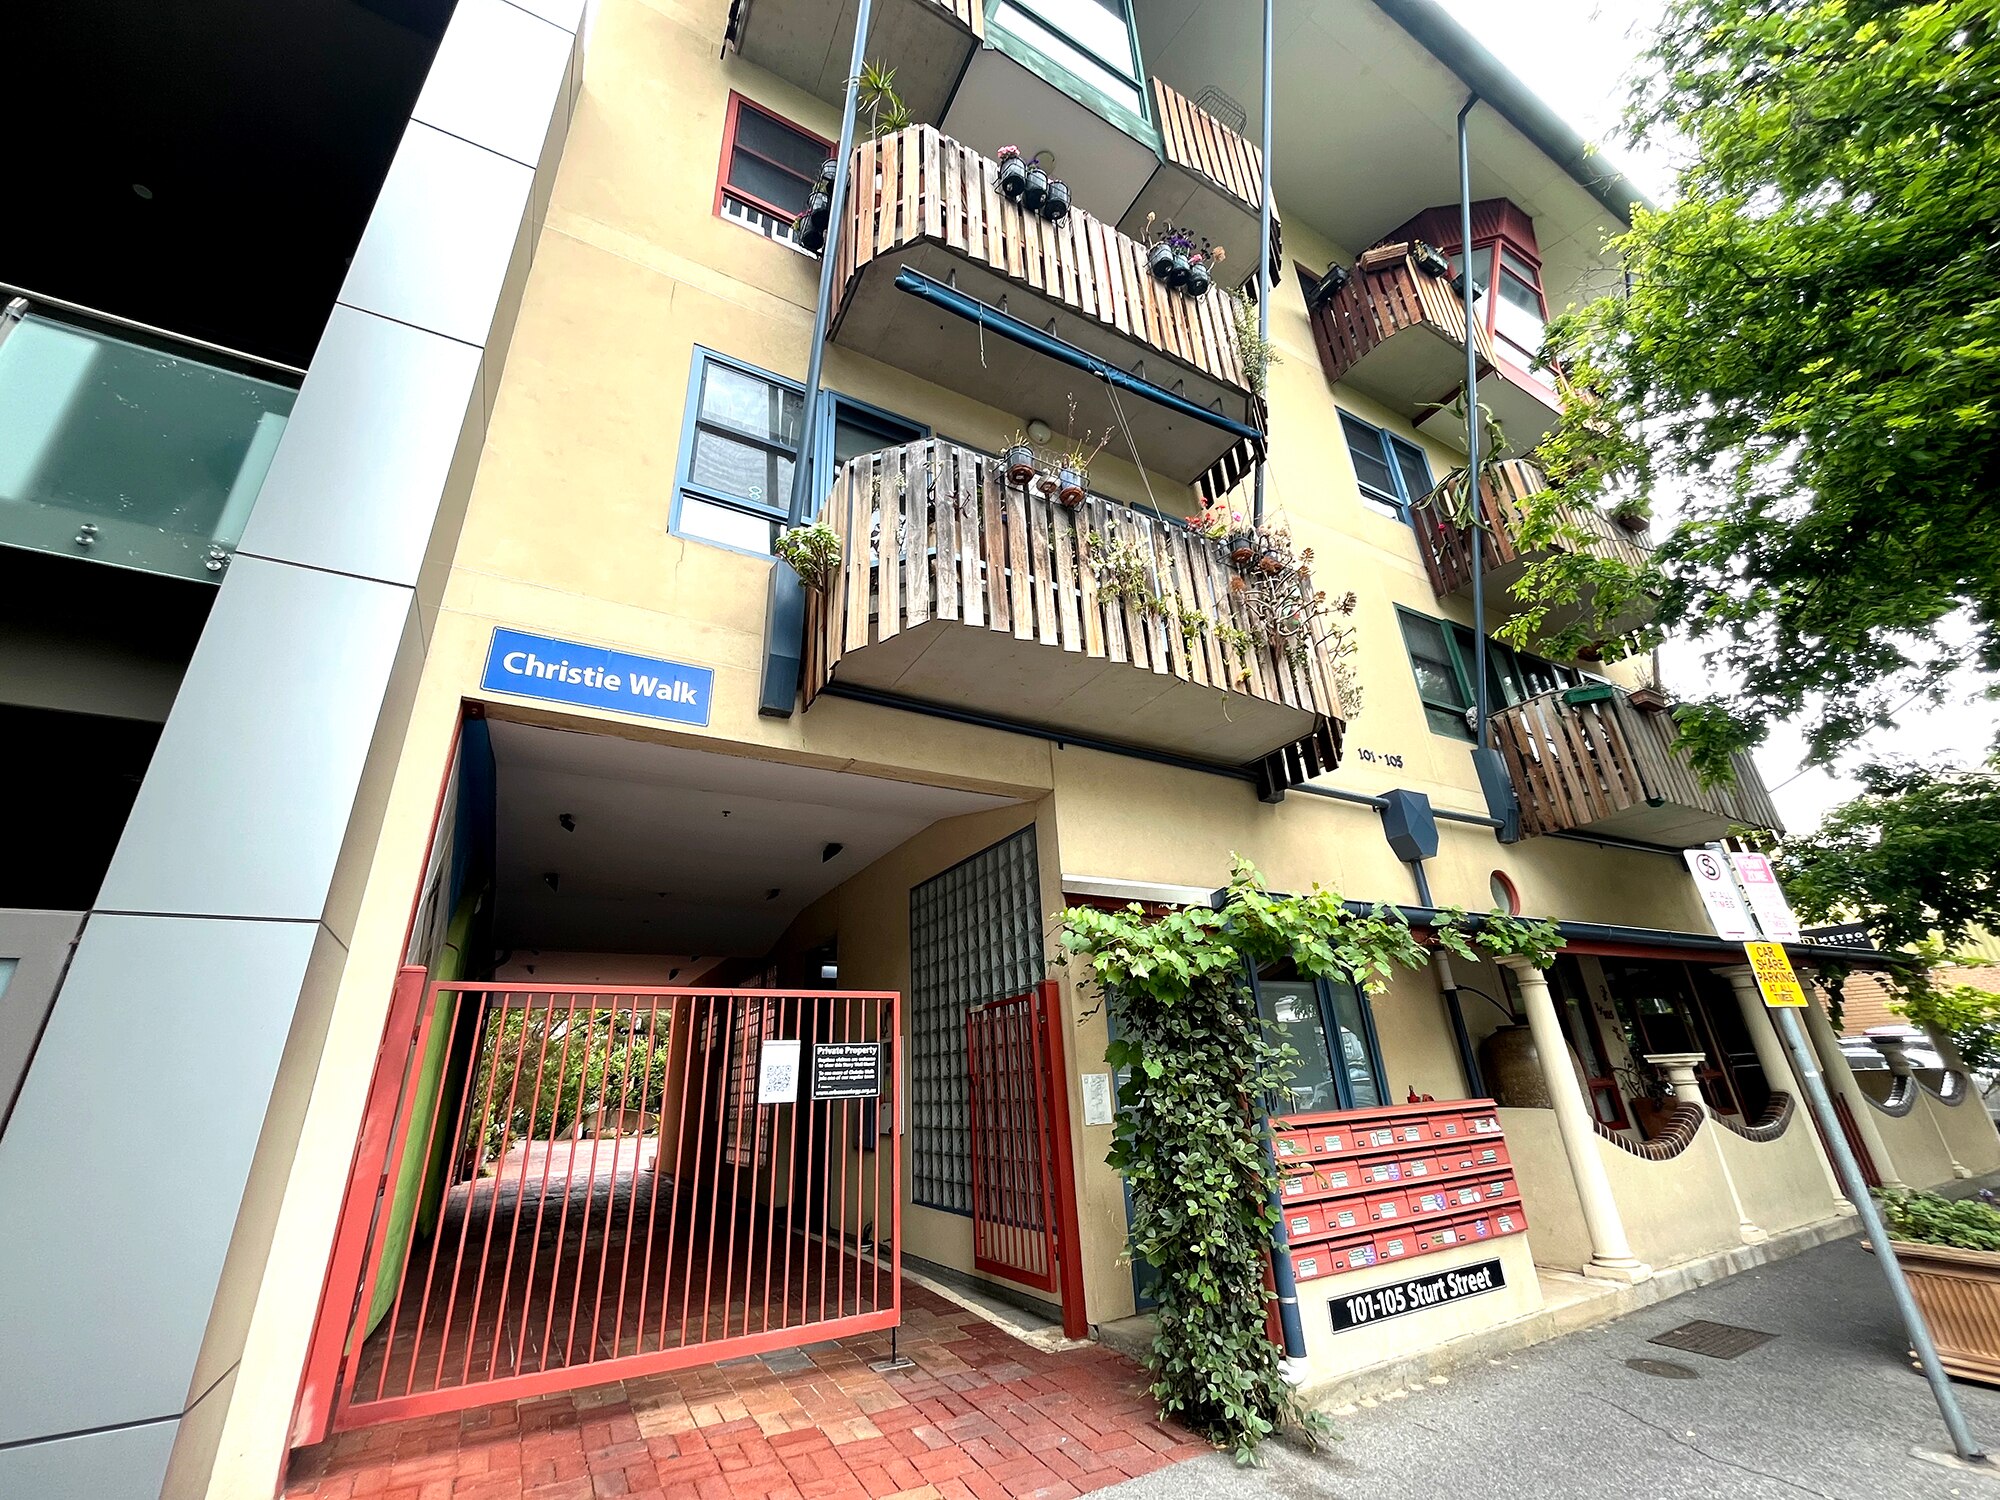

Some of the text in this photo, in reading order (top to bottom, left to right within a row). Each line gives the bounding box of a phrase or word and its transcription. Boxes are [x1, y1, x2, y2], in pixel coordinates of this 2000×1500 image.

[503, 651, 698, 705] Christie Walk
[1818, 932, 1863, 943] METRO
[1756, 946, 1776, 958] CAR
[1756, 958, 1786, 970] SHARE
[1756, 971, 1796, 983] PARKING
[1769, 984, 1794, 993] AT ALL
[1774, 993, 1795, 1002] TIMES
[816, 1046, 878, 1056] Private Property
[1346, 1266, 1493, 1323] 101-105 Sturt Street
